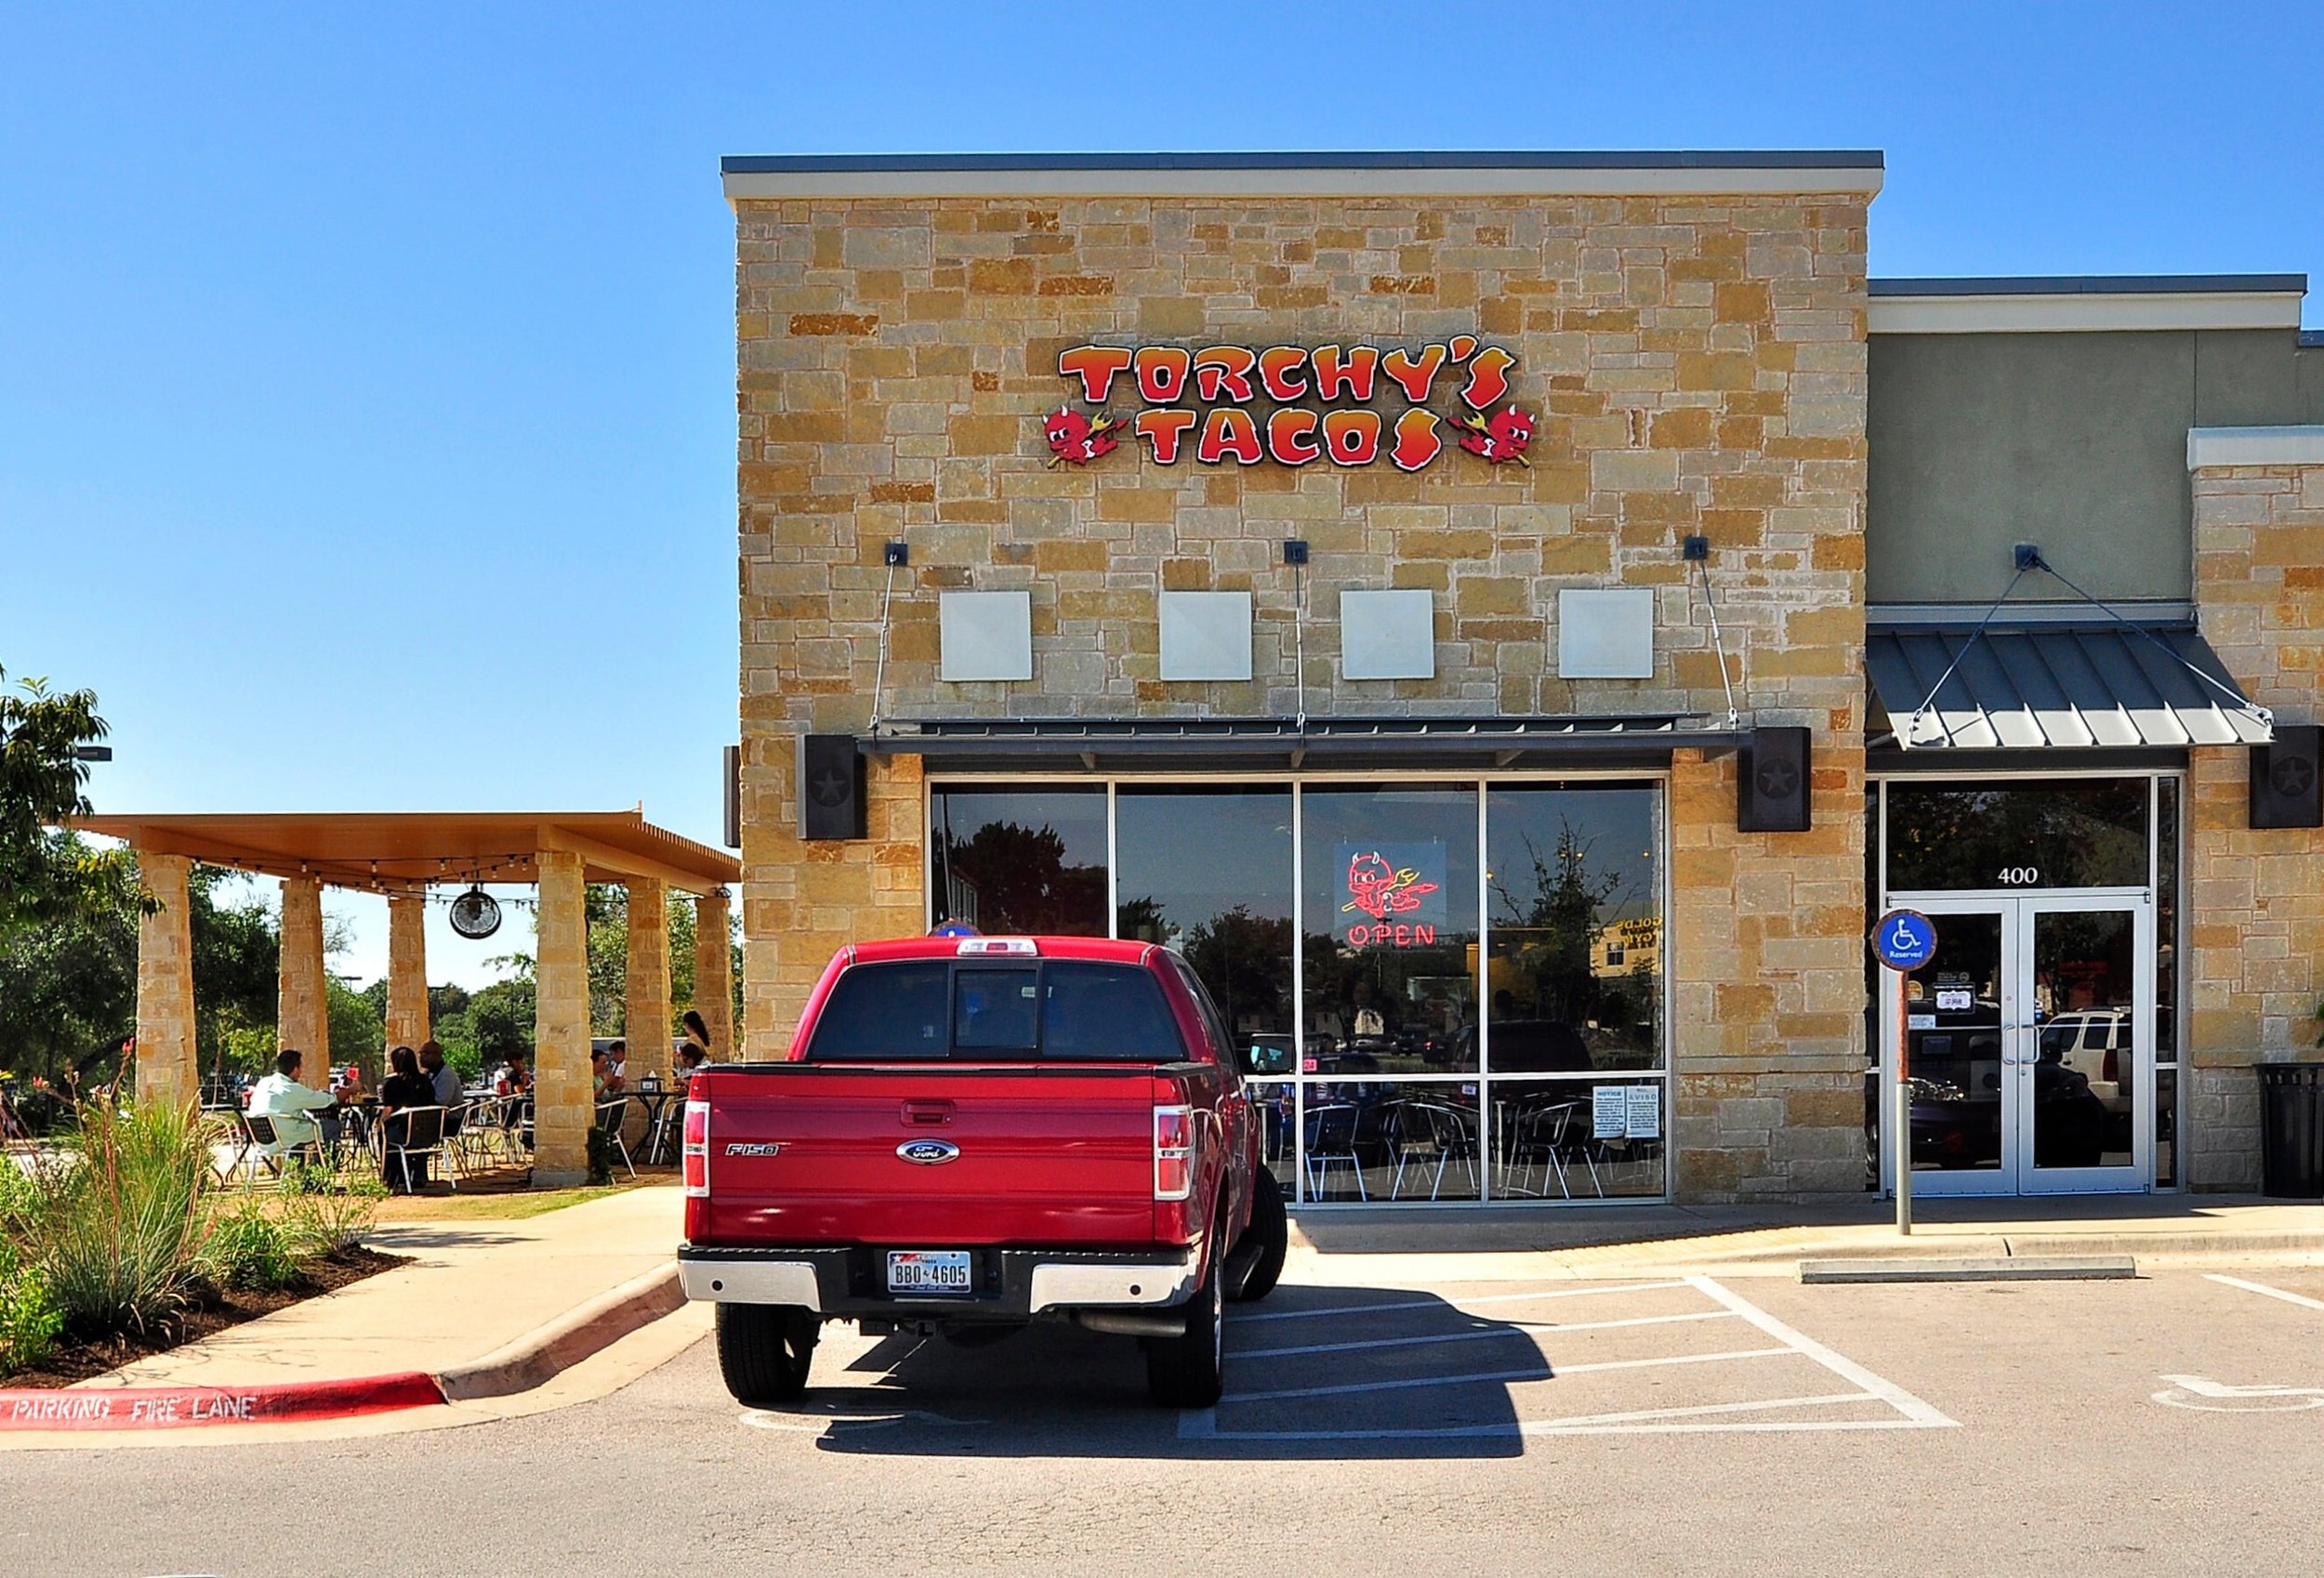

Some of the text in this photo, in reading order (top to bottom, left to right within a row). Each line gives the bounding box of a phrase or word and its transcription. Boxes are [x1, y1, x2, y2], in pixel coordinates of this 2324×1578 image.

[1059, 335, 1516, 410] TORCHY'S
[1135, 406, 1444, 472] TACOS
[1998, 867, 2039, 884] 400
[1348, 924, 1435, 946] OPEN
[1889, 950, 1923, 958] Reserved
[913, 1145, 941, 1158] Ford
[931, 1265, 966, 1284] 4605
[11, 1397, 111, 1421] PARKING
[130, 1399, 182, 1421] FIRE
[191, 1395, 257, 1421] LANE
